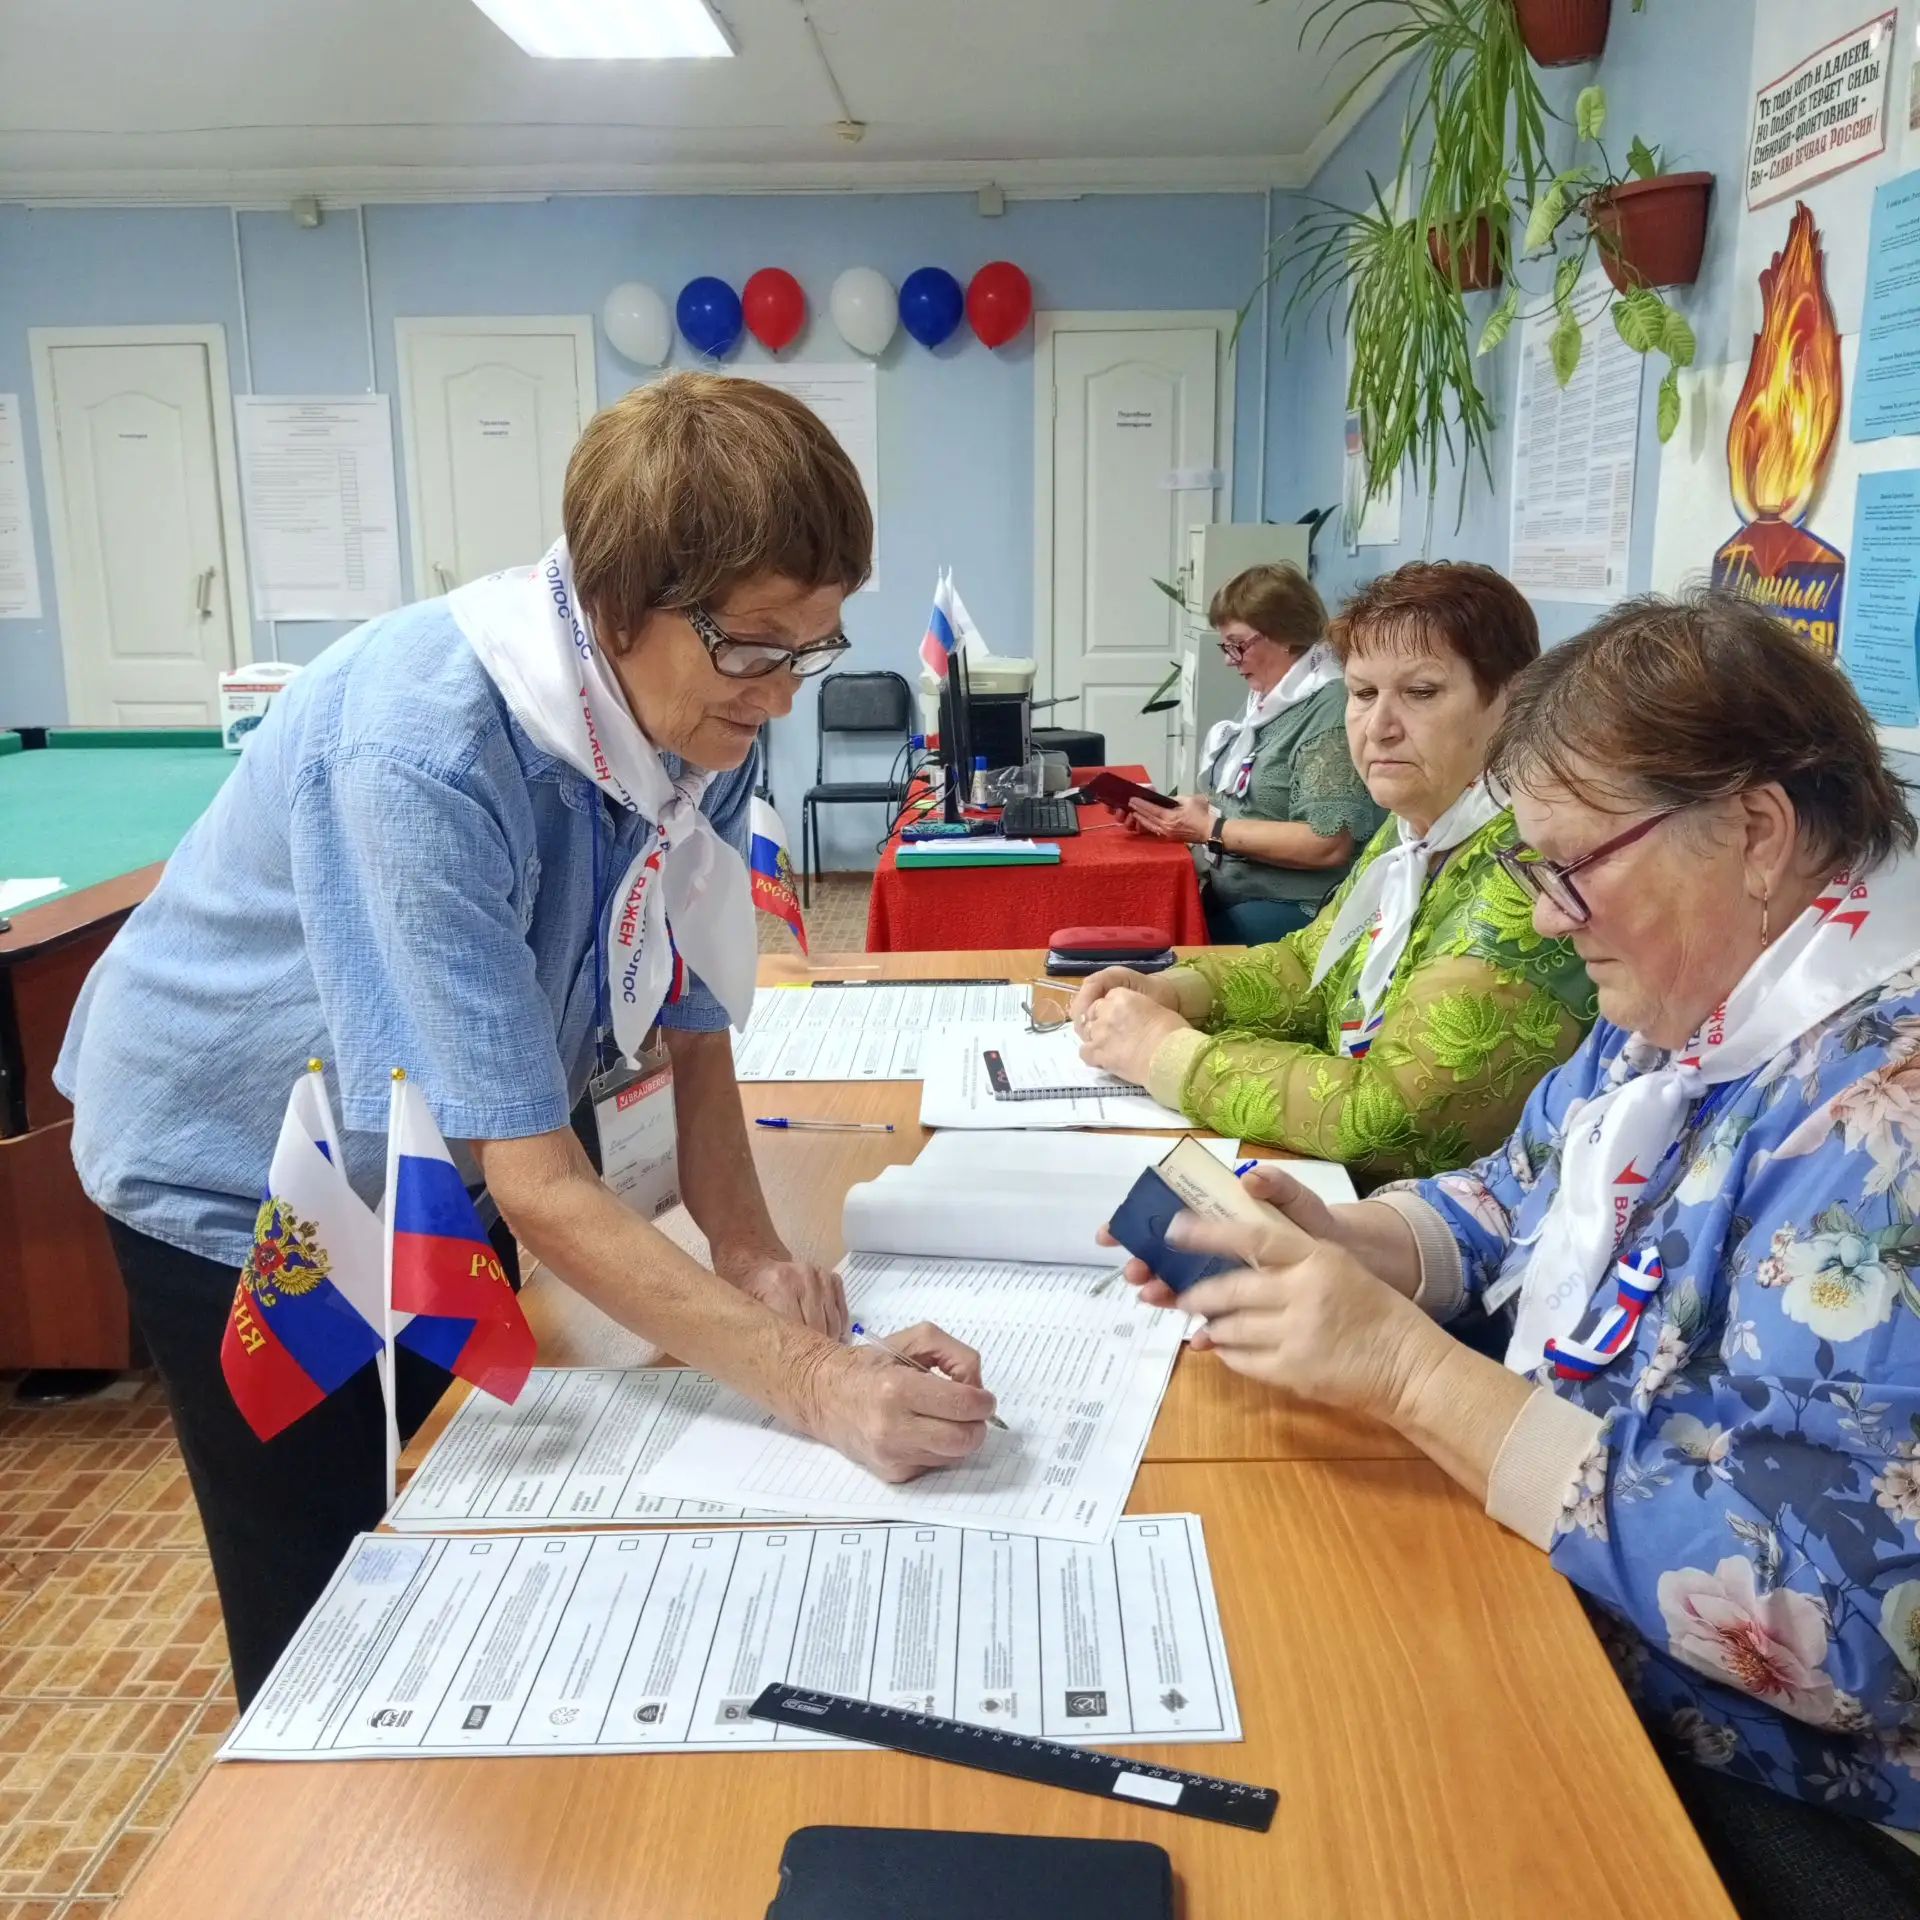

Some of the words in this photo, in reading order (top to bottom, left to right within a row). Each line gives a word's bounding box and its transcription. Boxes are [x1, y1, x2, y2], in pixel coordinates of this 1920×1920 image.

[1756, 122, 1769, 145] НО
[1808, 78, 1844, 113] ТЕРЯЕТ
[1772, 85, 1794, 113] ГОДЫ
[627, 1074, 667, 1102] BRAUBERG
[1148, 1769, 1162, 1778] 20
[1168, 1773, 1181, 1782] 21
[1188, 1777, 1202, 1786] 22
[1208, 1782, 1224, 1791] 23
[1230, 1787, 1245, 1796] 24
[1252, 1790, 1267, 1800] 25
